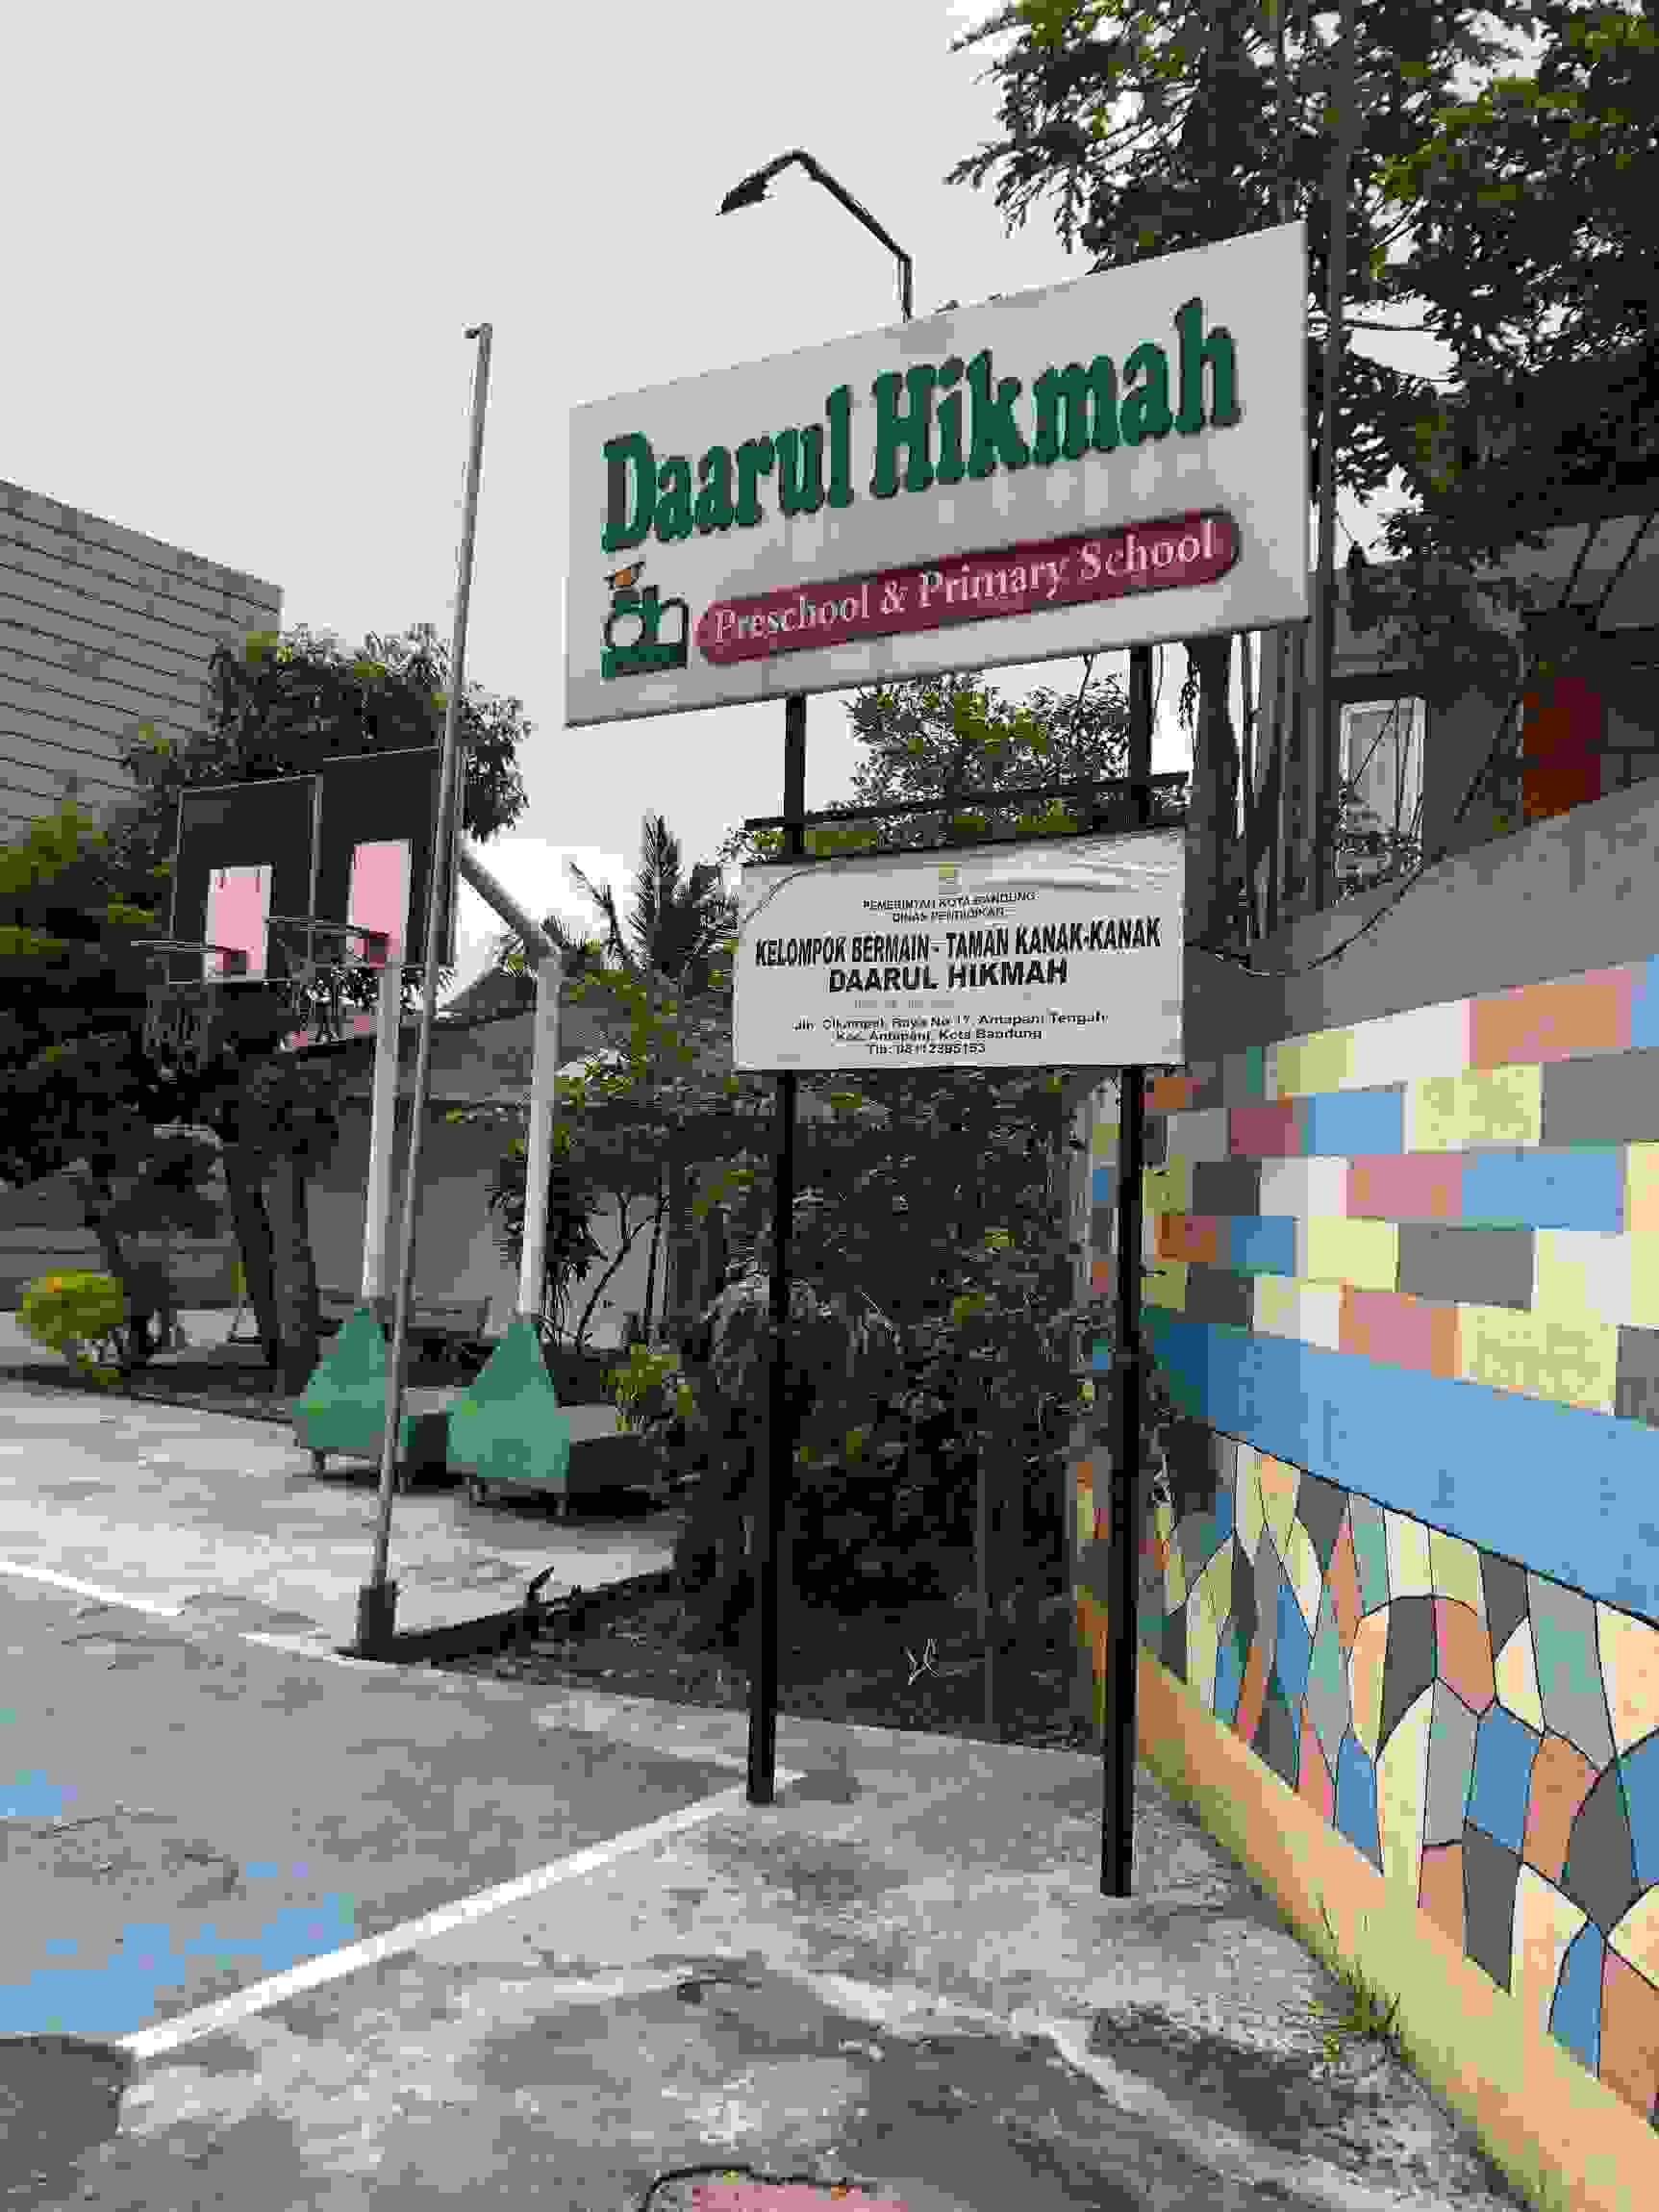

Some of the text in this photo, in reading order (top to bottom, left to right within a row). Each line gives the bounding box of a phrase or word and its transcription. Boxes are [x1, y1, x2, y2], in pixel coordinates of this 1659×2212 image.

[600, 297, 1243, 554] Daarul Hikmah
[716, 517, 1214, 641] Preschool & Primary School
[755, 936, 847, 967] KELOMPOK
[851, 932, 930, 963] BERMAIN
[945, 927, 1009, 960] TAMAN
[1015, 916, 1162, 954] KANAK-KANAK
[830, 958, 1068, 992] DAARUL HIKMAH
[939, 1029, 970, 1040] Kota
[976, 1027, 1042, 1041] Bandung
